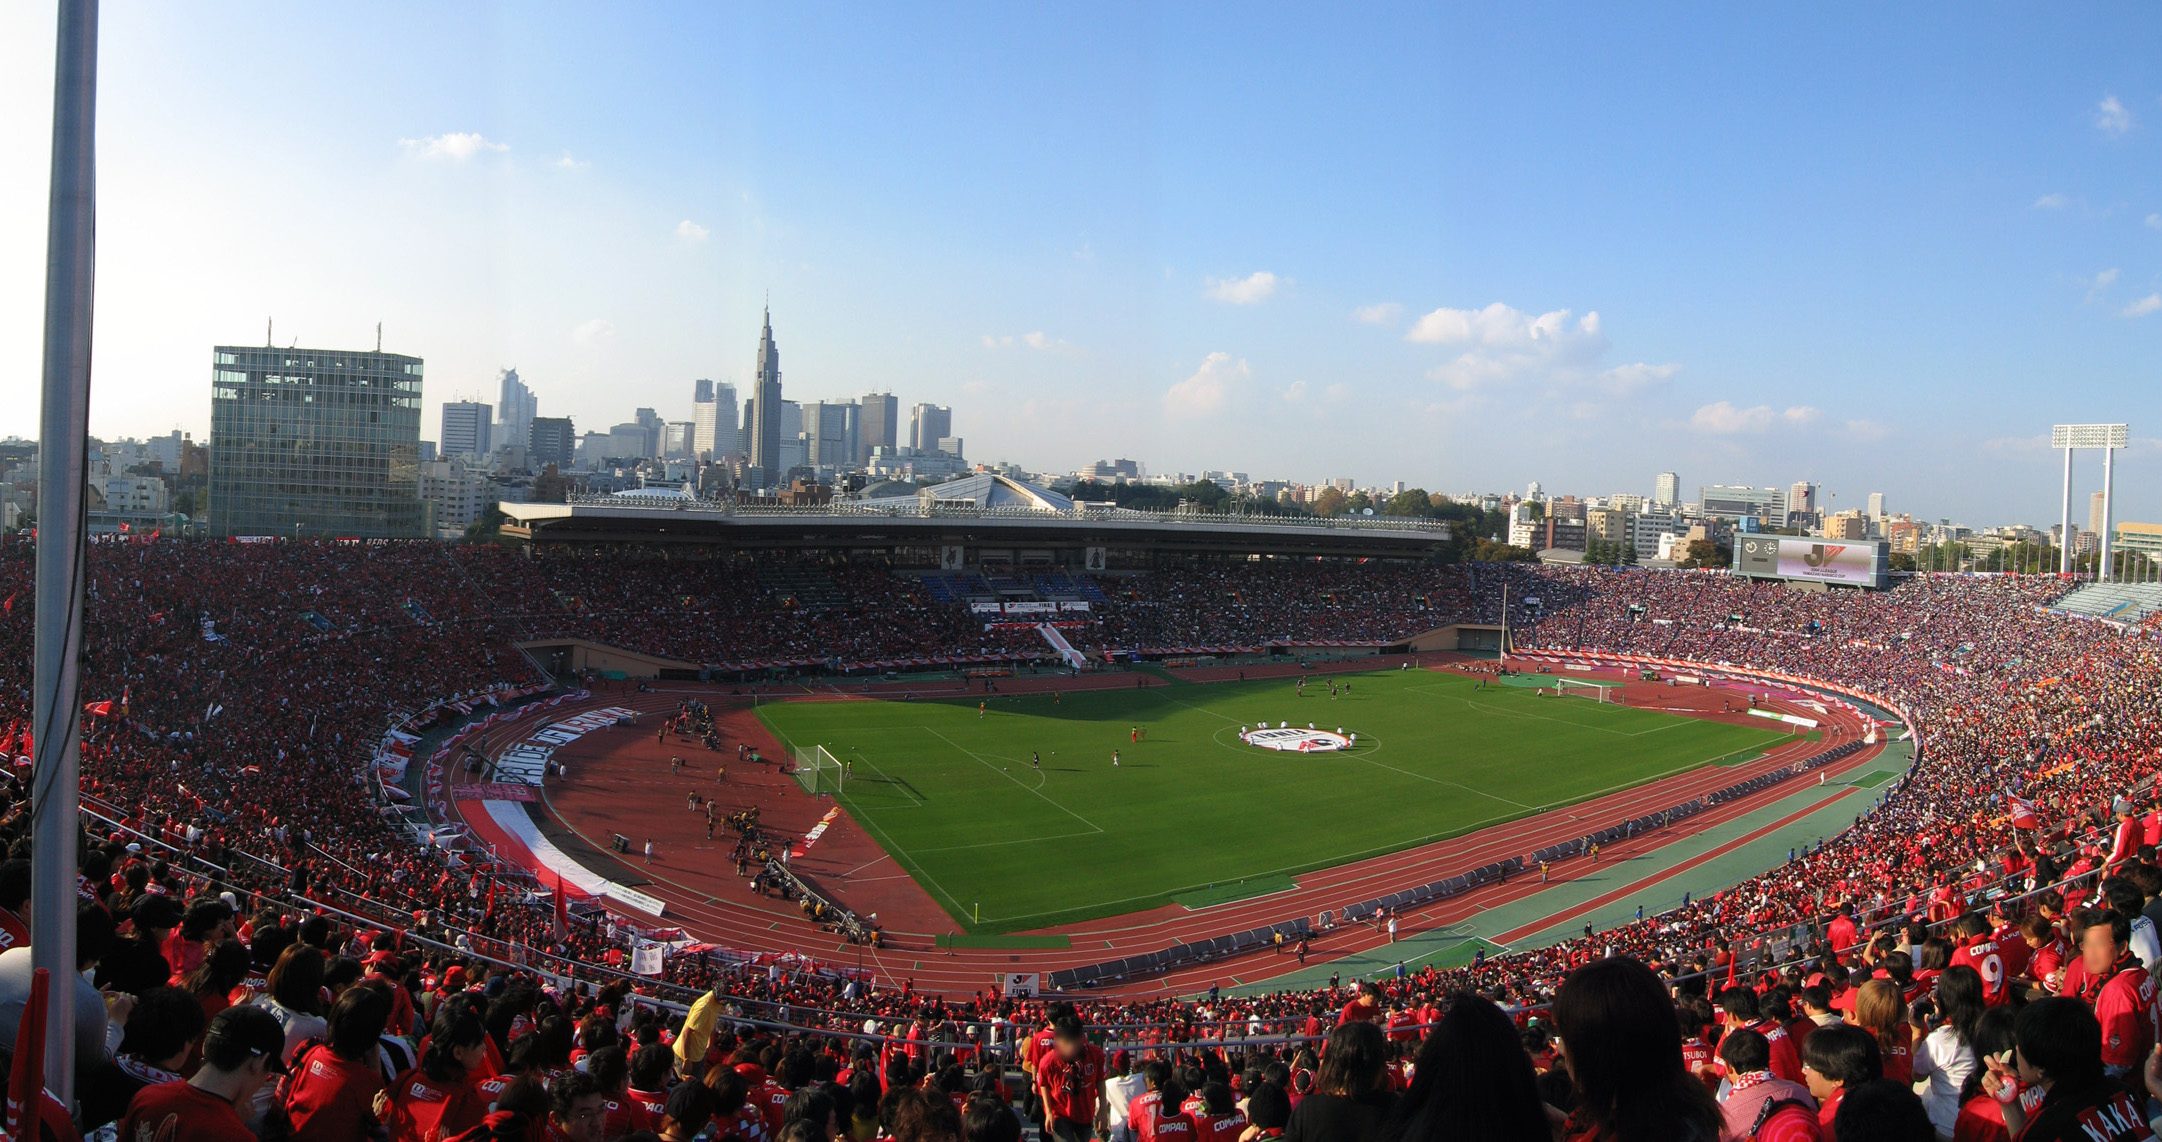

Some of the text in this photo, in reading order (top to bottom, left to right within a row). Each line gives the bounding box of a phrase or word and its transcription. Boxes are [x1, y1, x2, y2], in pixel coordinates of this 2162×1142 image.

[495, 743, 554, 786] PRIDE
[1981, 954, 2003, 993] 9
[1683, 1050, 1708, 1060] TSUBOI
[1159, 1122, 1188, 1134] COMPAQ
[1213, 1113, 1245, 1132] COMPAQ
